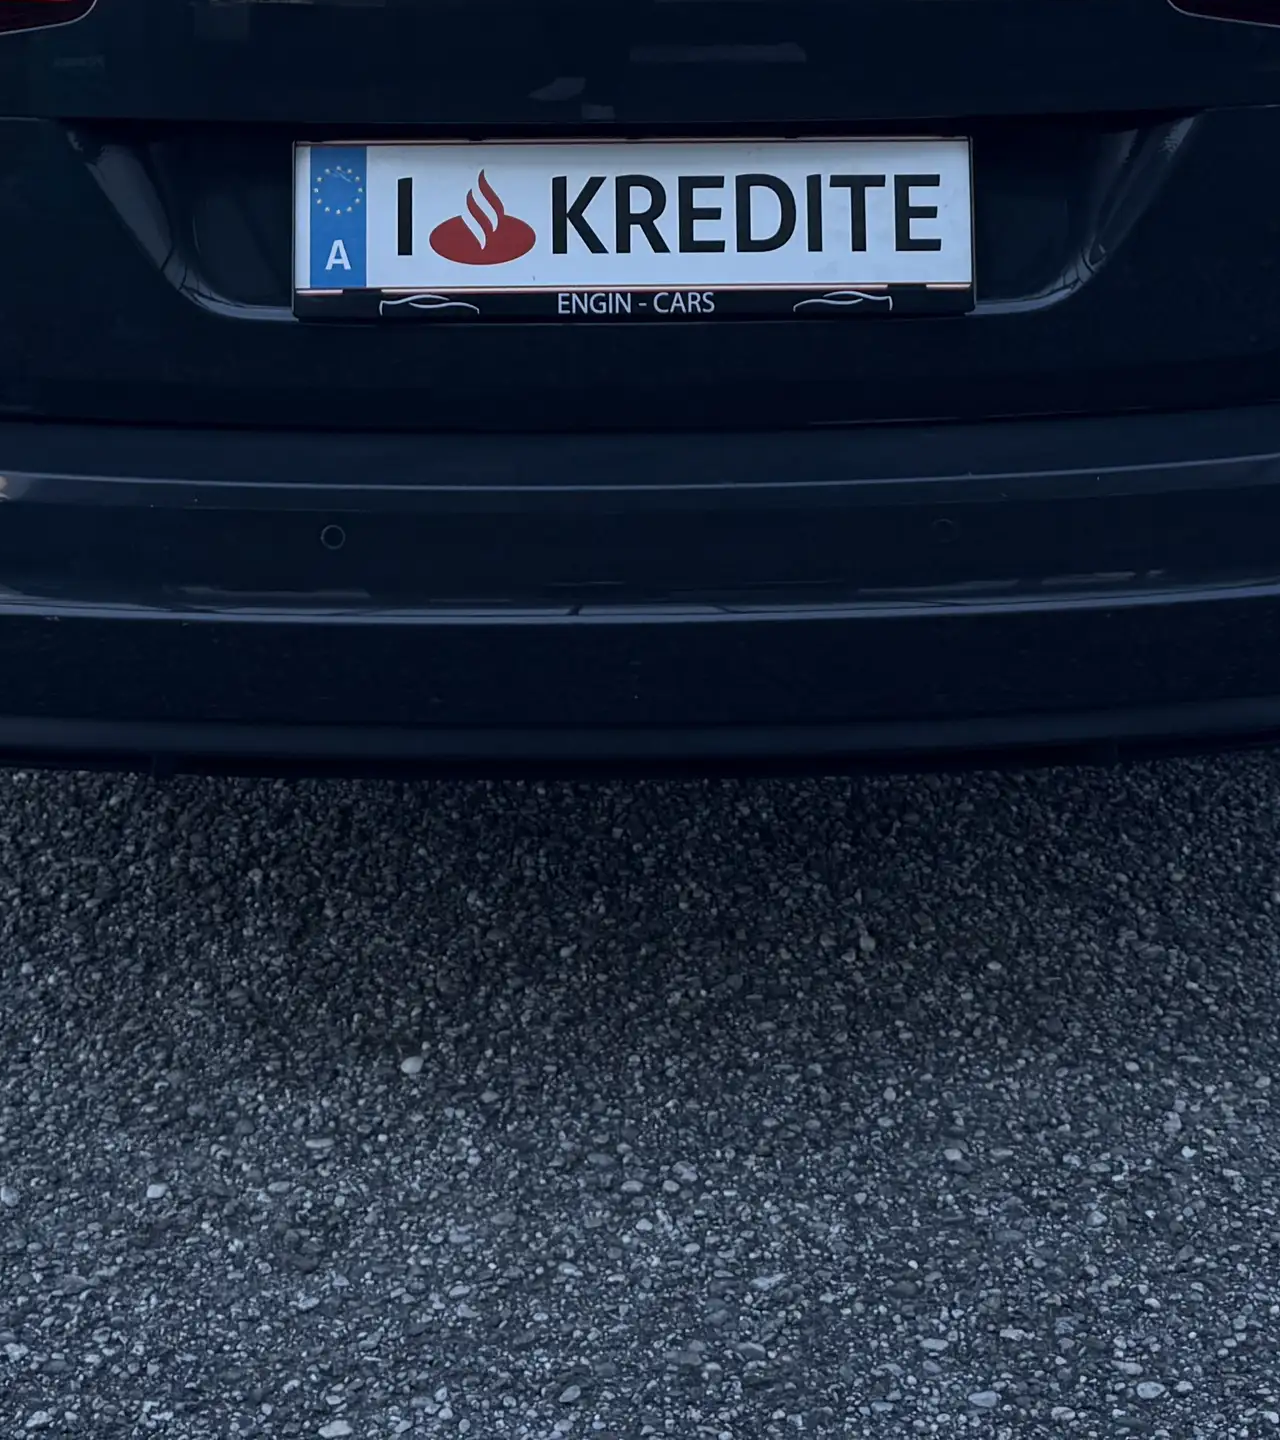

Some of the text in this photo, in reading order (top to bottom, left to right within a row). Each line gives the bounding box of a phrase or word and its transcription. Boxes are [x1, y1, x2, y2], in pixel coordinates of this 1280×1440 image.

[396, 173, 942, 257] I KREDITE
[324, 238, 352, 271] A
[557, 292, 632, 314] ENGIN
[653, 291, 715, 314] CARS
